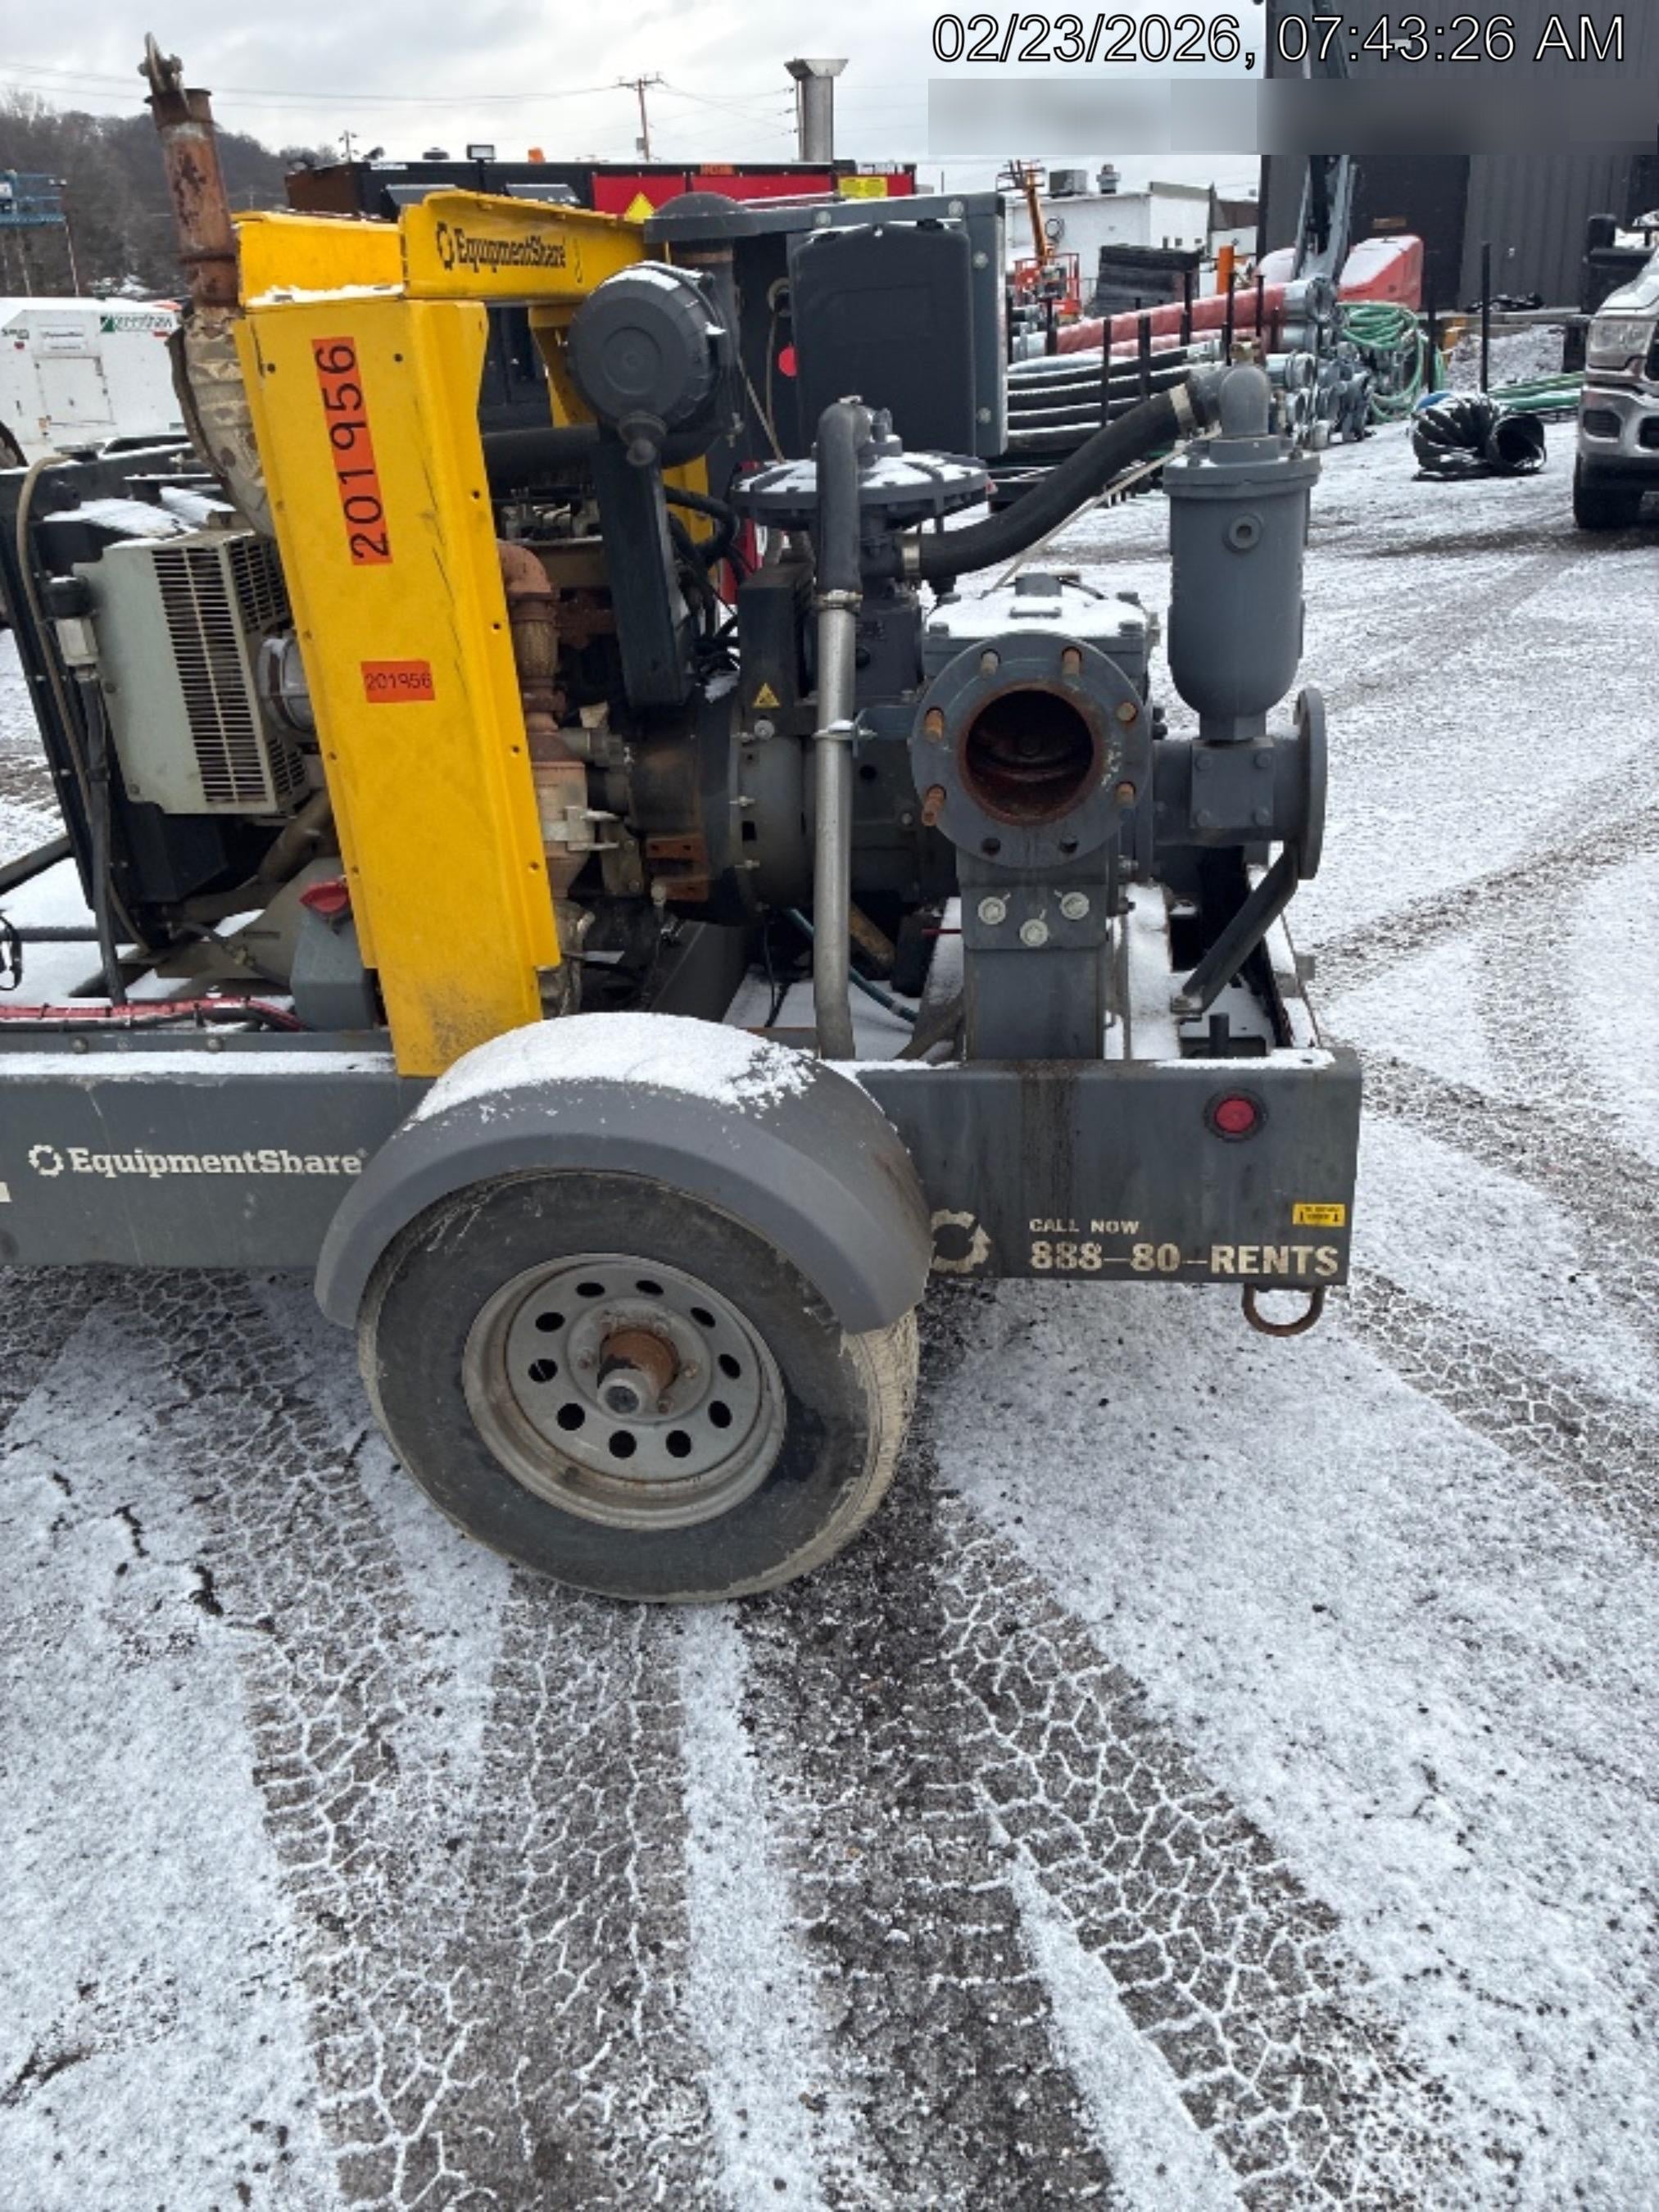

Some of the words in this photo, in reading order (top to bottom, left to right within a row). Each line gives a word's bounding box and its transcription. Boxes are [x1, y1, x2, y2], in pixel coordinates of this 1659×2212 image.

[315, 345, 390, 558] 201956
[365, 673, 432, 691] 201956
[66, 1147, 363, 1178] EquipmentShare
[1028, 1218, 1080, 1233] CALL
[1090, 1219, 1140, 1235] NOW
